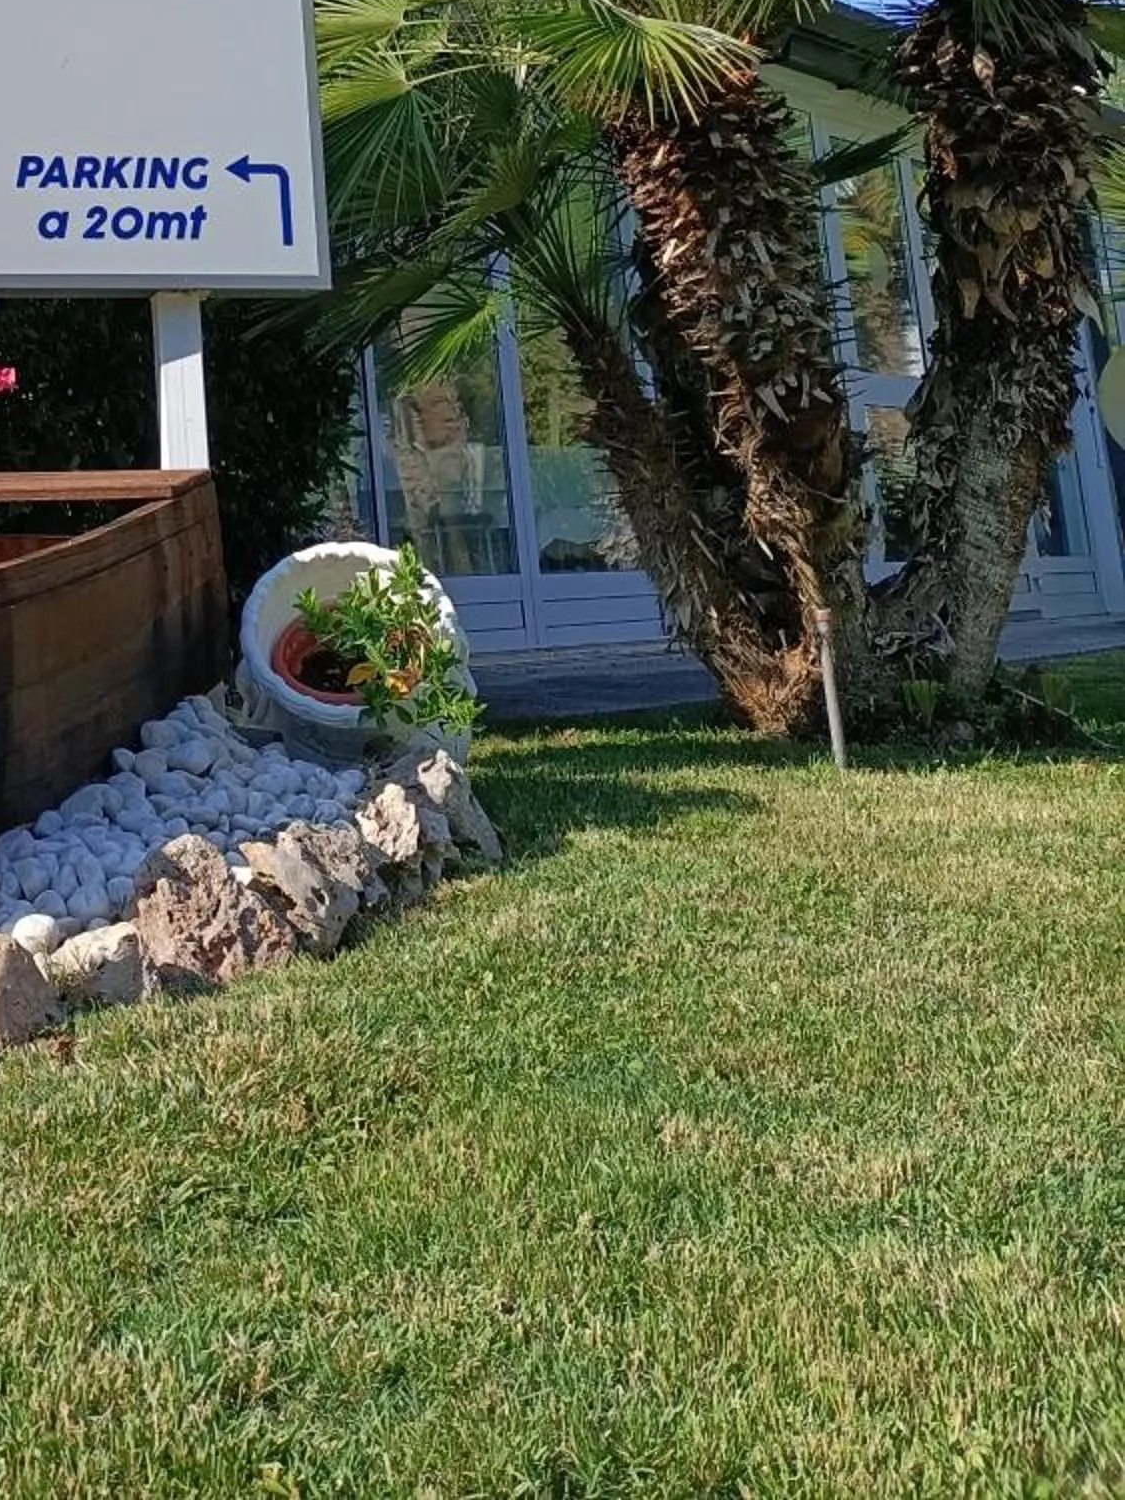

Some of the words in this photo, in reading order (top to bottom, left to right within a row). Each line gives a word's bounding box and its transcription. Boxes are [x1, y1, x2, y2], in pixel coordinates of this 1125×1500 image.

[15, 154, 210, 191] PARKING
[37, 209, 71, 241] a
[82, 204, 209, 241] 20mt
